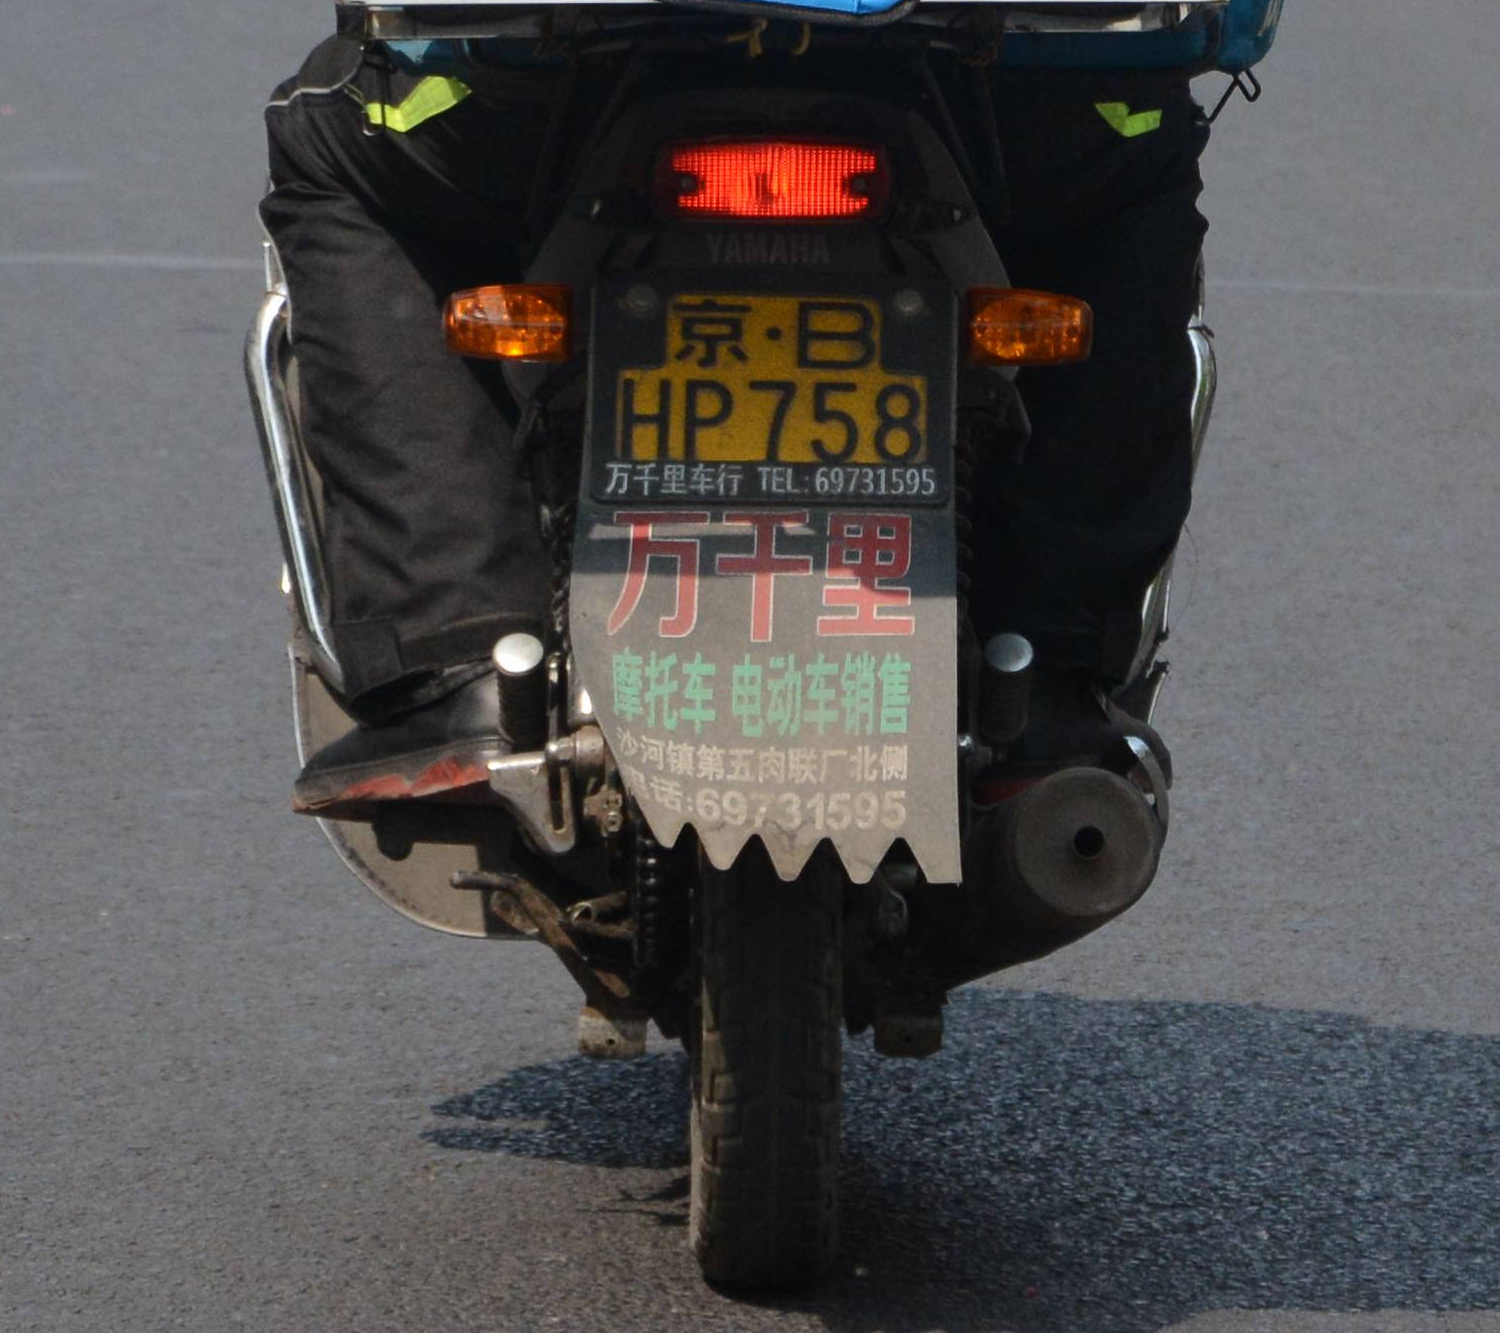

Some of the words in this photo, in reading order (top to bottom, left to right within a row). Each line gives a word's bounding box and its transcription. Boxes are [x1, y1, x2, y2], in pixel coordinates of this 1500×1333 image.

[706, 233, 832, 264] YAMAHA
[621, 379, 922, 465] HP758
[604, 463, 744, 496] 万千里车行
[607, 511, 916, 643] 万千里
[612, 646, 716, 735] 摩托车
[731, 651, 912, 739] 电动车销售
[616, 727, 909, 784] 沙河镇第五肉联厂北侧
